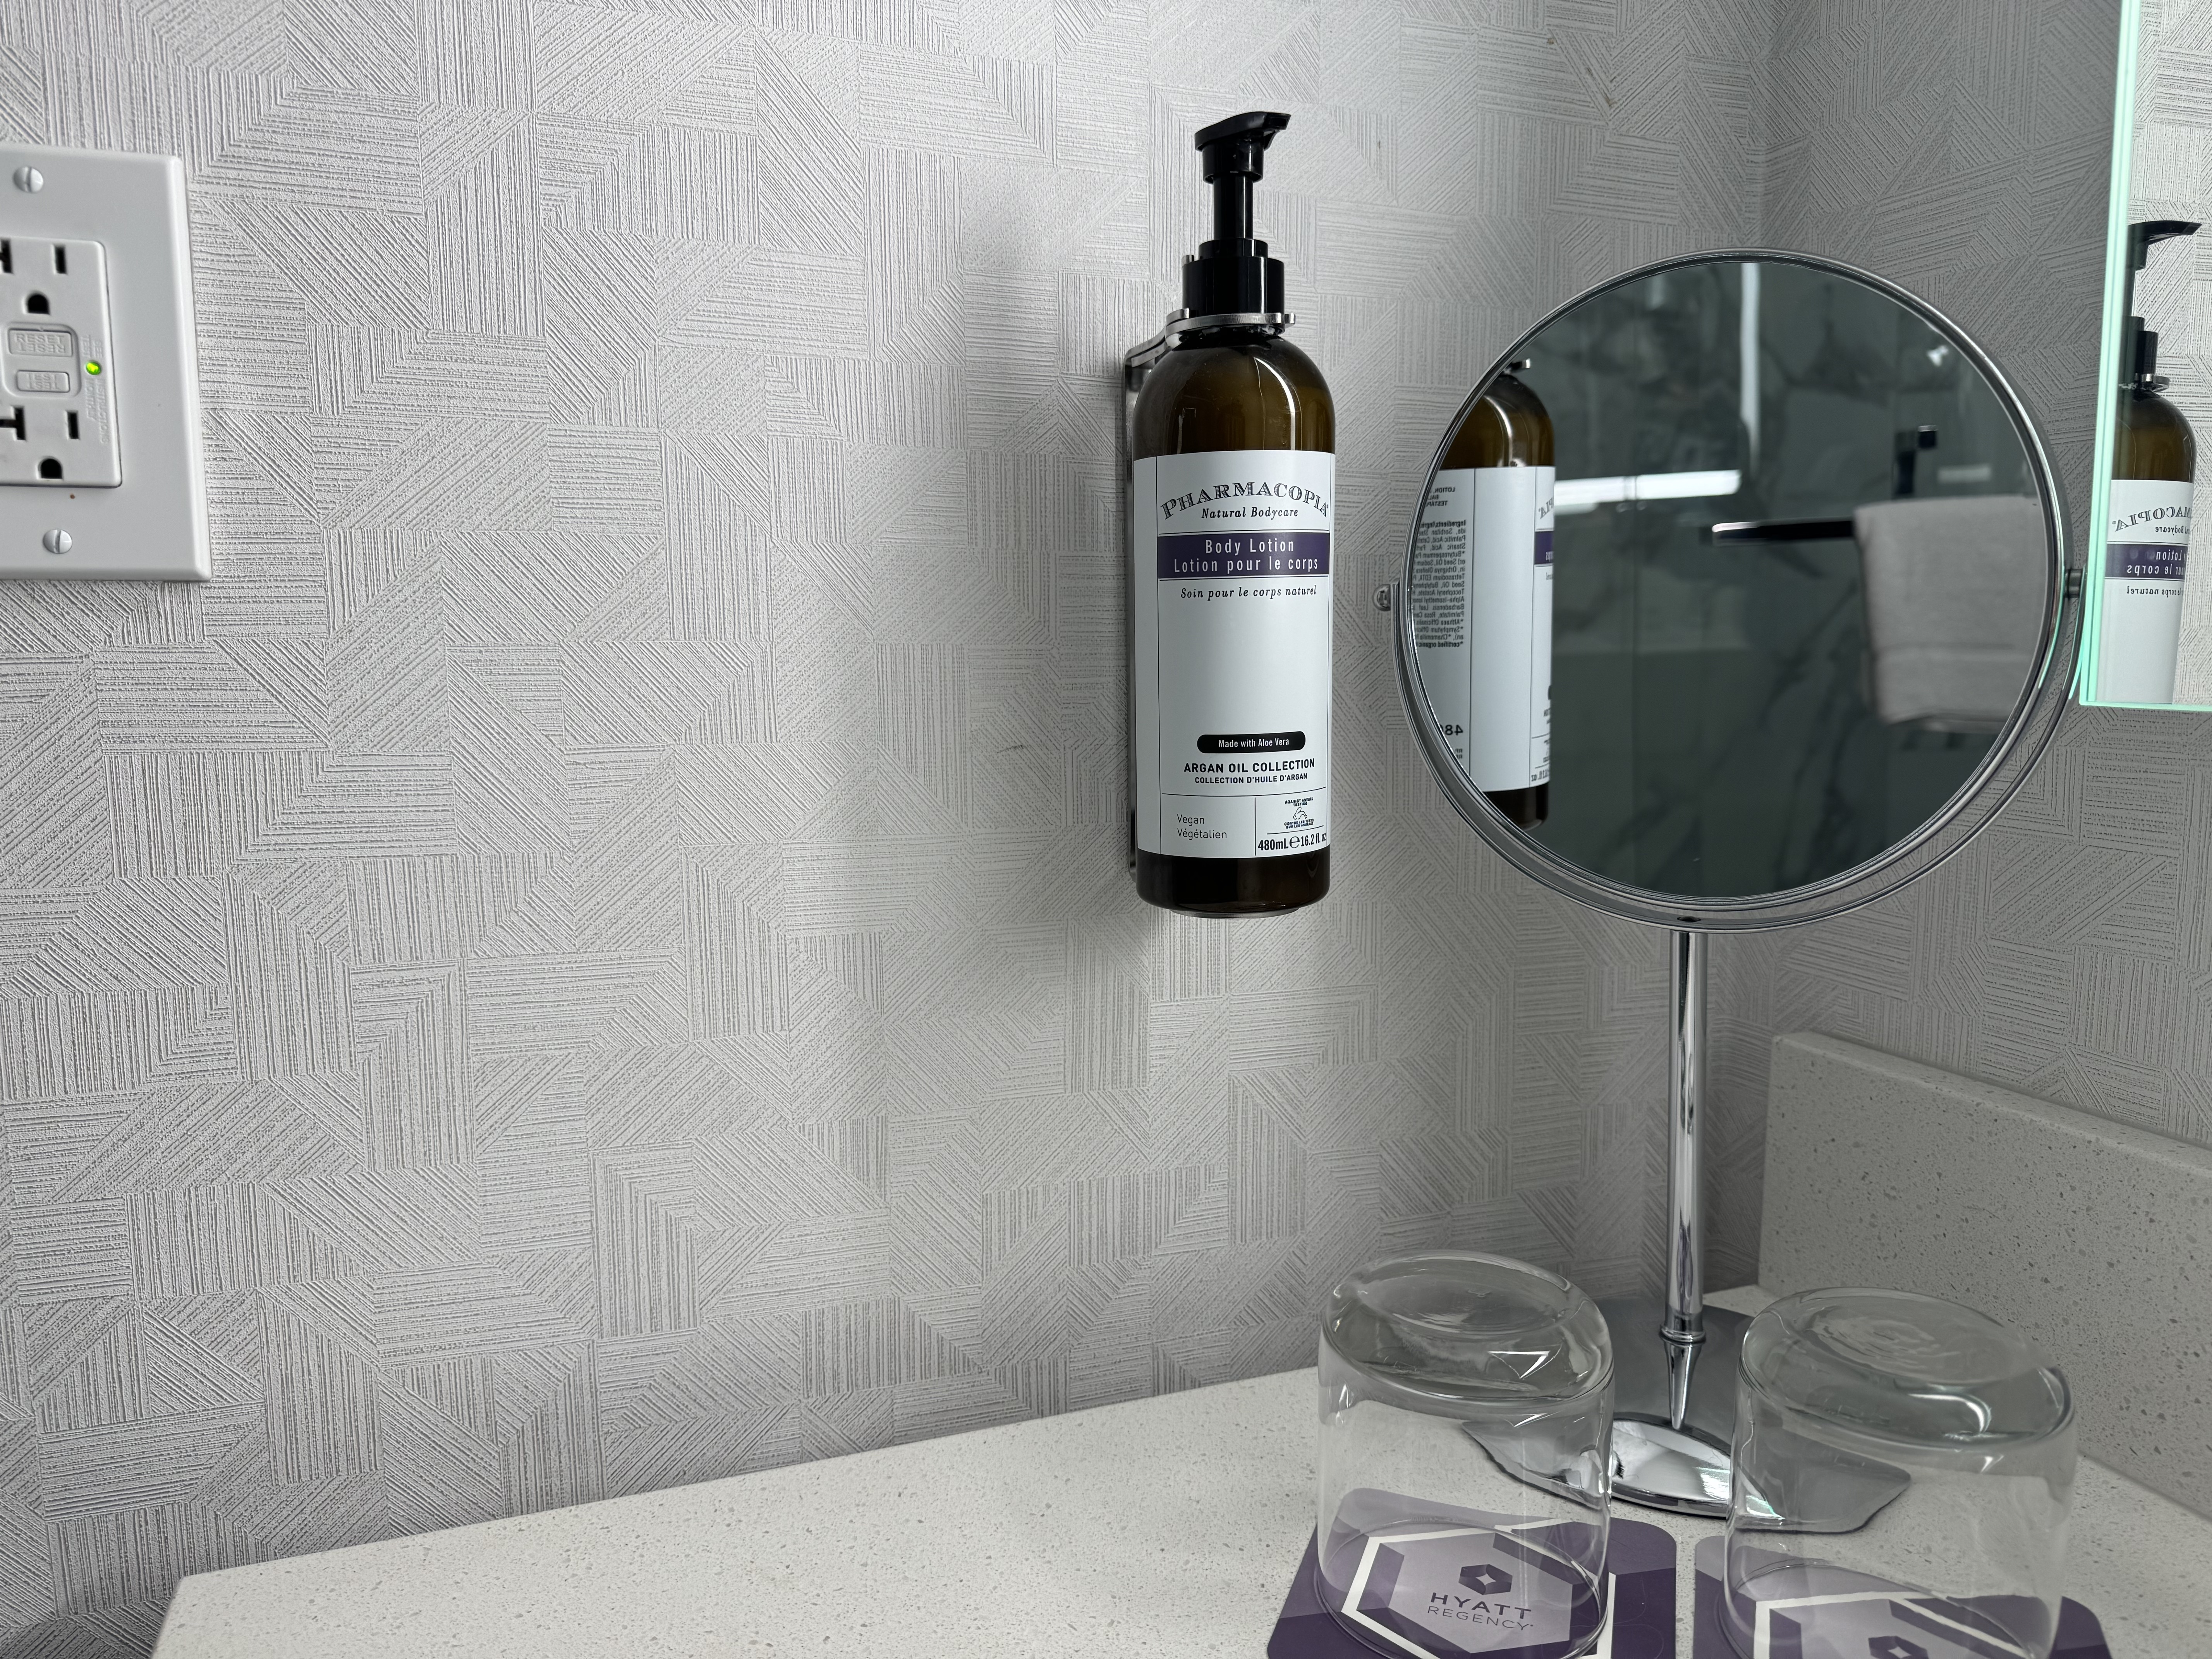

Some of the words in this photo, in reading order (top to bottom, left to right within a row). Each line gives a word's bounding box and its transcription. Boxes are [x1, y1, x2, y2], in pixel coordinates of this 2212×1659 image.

[15, 334, 65, 344] RESET
[1201, 507, 1246, 519] Natural
[1250, 507, 1298, 520] Bodycare
[1206, 539, 1241, 556] Body
[1250, 538, 1294, 553] Lotion
[1174, 558, 1218, 573] Lotion
[1227, 558, 1261, 574] pour
[1269, 556, 1281, 570] le
[1288, 558, 1318, 572] corps
[1181, 588, 1204, 599] Soin
[1207, 589, 1234, 601] pour
[1239, 587, 1248, 597] le
[1253, 587, 1281, 599] corps
[1285, 585, 1316, 596] naturel
[1218, 739, 1238, 748] Made
[1240, 738, 1255, 747] with
[1258, 738, 1273, 747] Aloe
[1274, 737, 1289, 746] Vera
[1183, 763, 1224, 773] ARGAN
[1228, 762, 1248, 773] OIL
[1252, 758, 1315, 772] COLLECTION
[1247, 775, 1278, 783] D'HUILE
[1279, 773, 1307, 781] D'ARGAN
[1177, 814, 1205, 826] Vegan
[1177, 828, 1228, 840] Végétalien
[1431, 1592, 1531, 1619] HYATT
[1427, 1606, 1529, 1631] REGENCY
